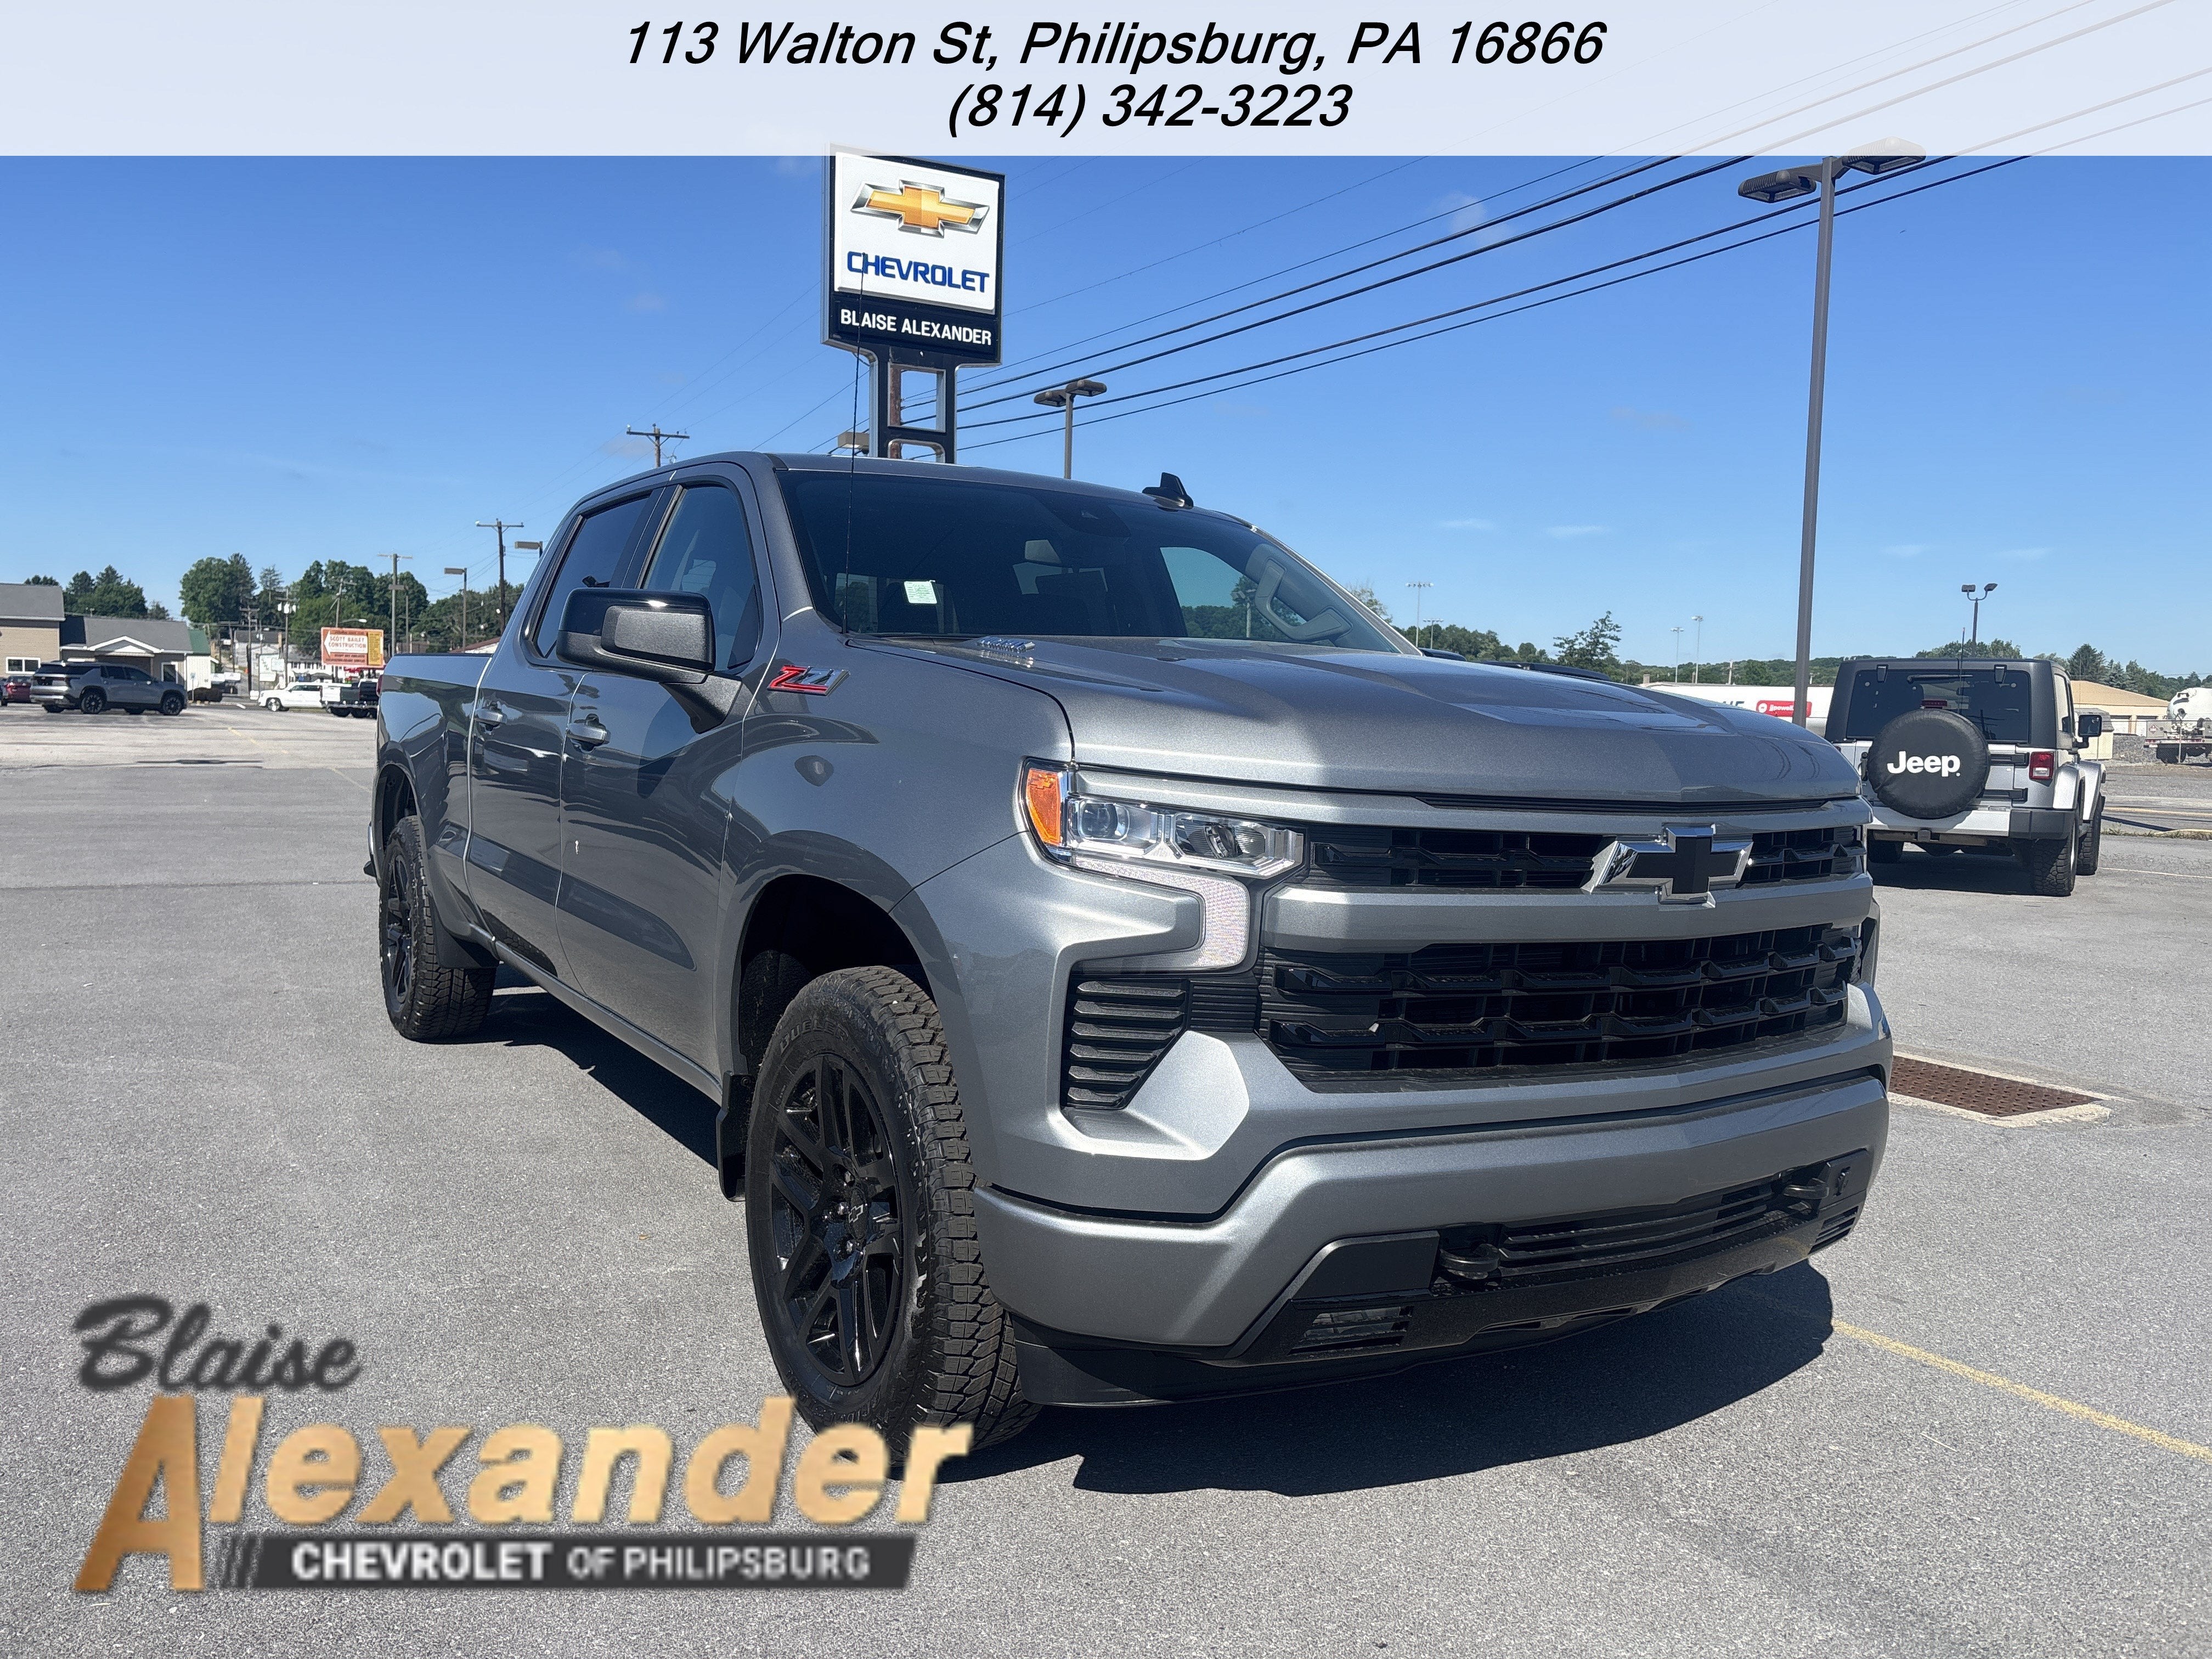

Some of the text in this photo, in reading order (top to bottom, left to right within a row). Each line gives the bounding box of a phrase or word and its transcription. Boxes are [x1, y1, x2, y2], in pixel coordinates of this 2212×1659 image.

[847, 251, 989, 292] CHEVROLET
[840, 308, 991, 346] BLAISE ALEXANDER
[1887, 751, 1961, 777] Jeep
